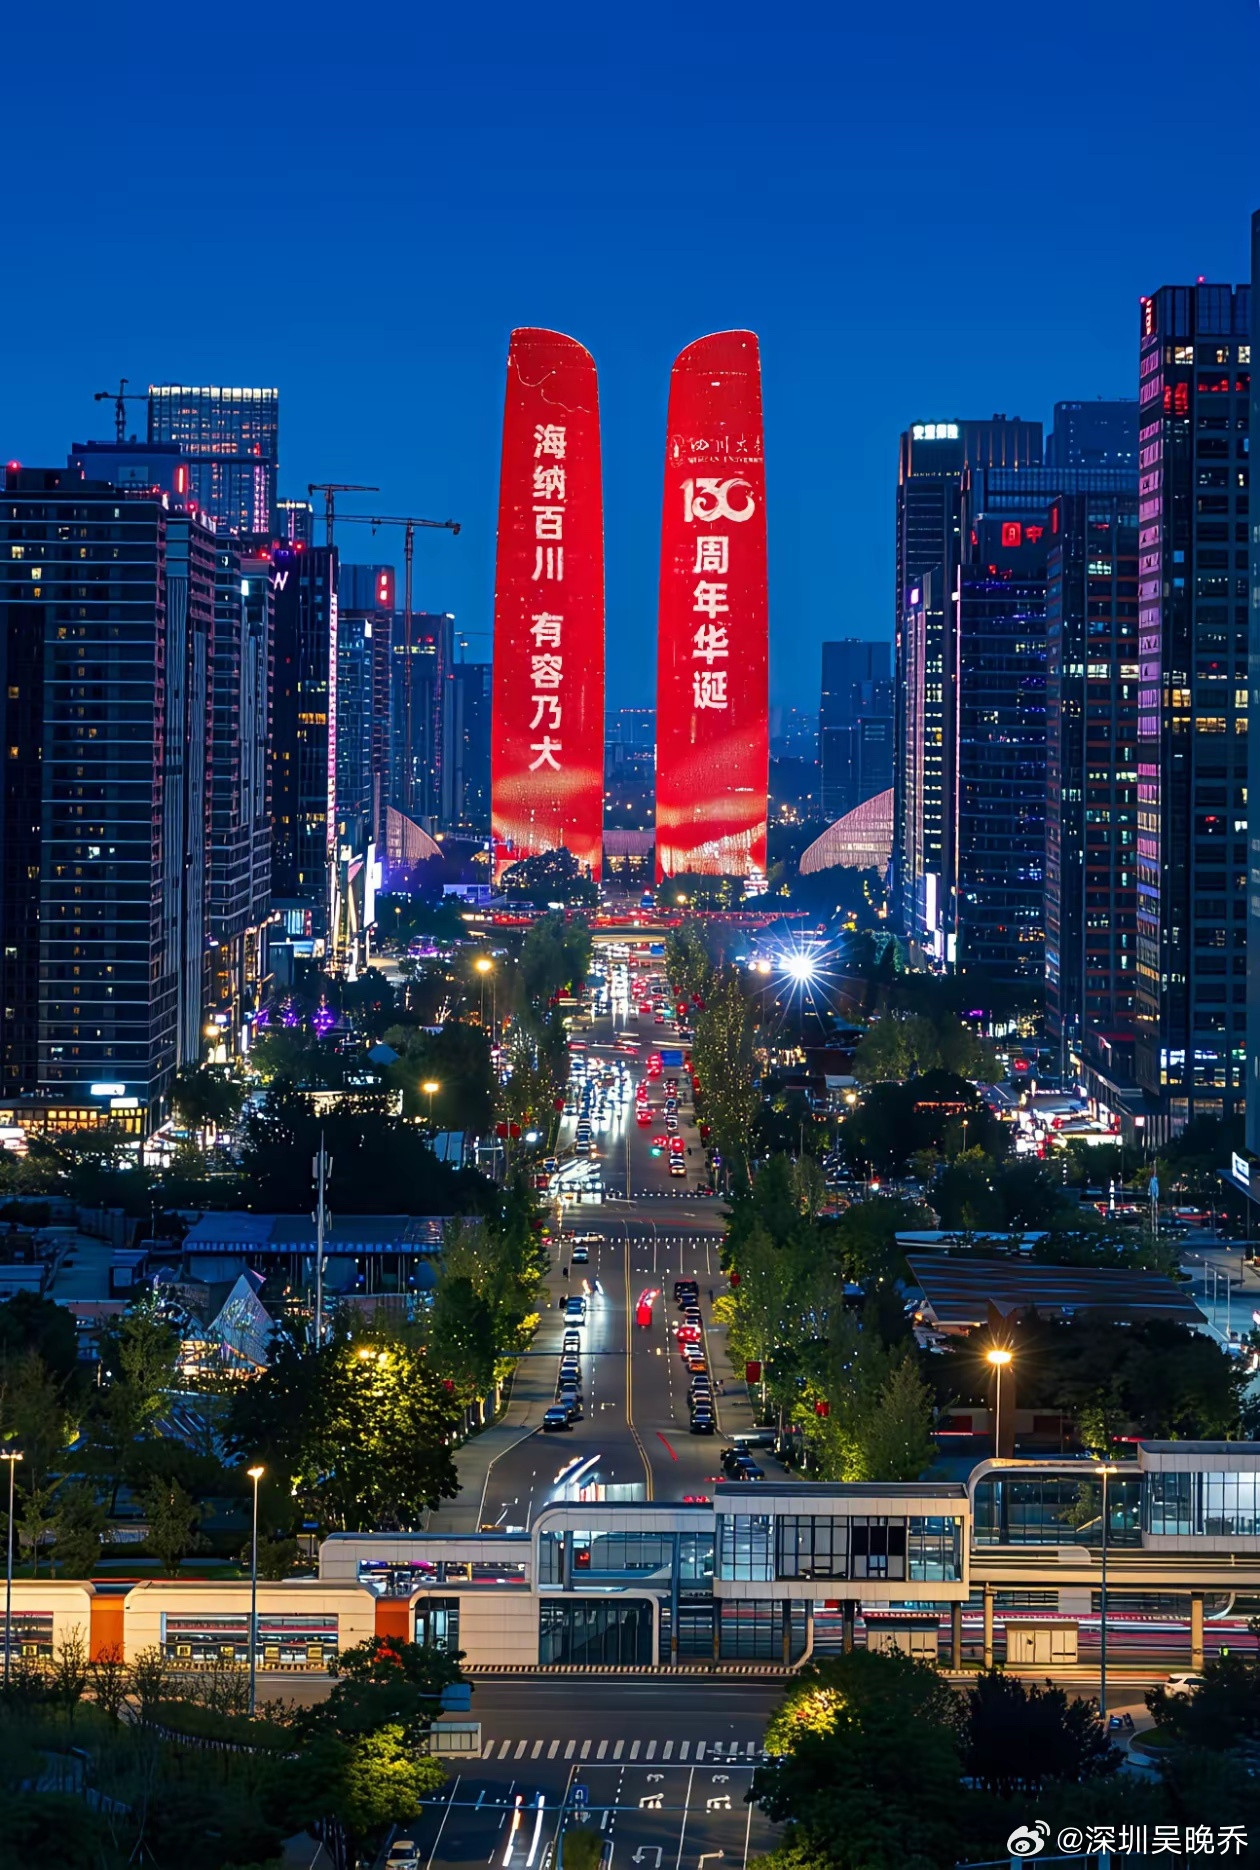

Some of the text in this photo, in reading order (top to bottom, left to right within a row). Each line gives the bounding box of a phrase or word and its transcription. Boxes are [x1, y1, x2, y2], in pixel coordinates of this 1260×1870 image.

[679, 477, 756, 523] 130
[528, 423, 567, 771] 海纳百川 有容乃大
[692, 536, 730, 709] 周年华诞
